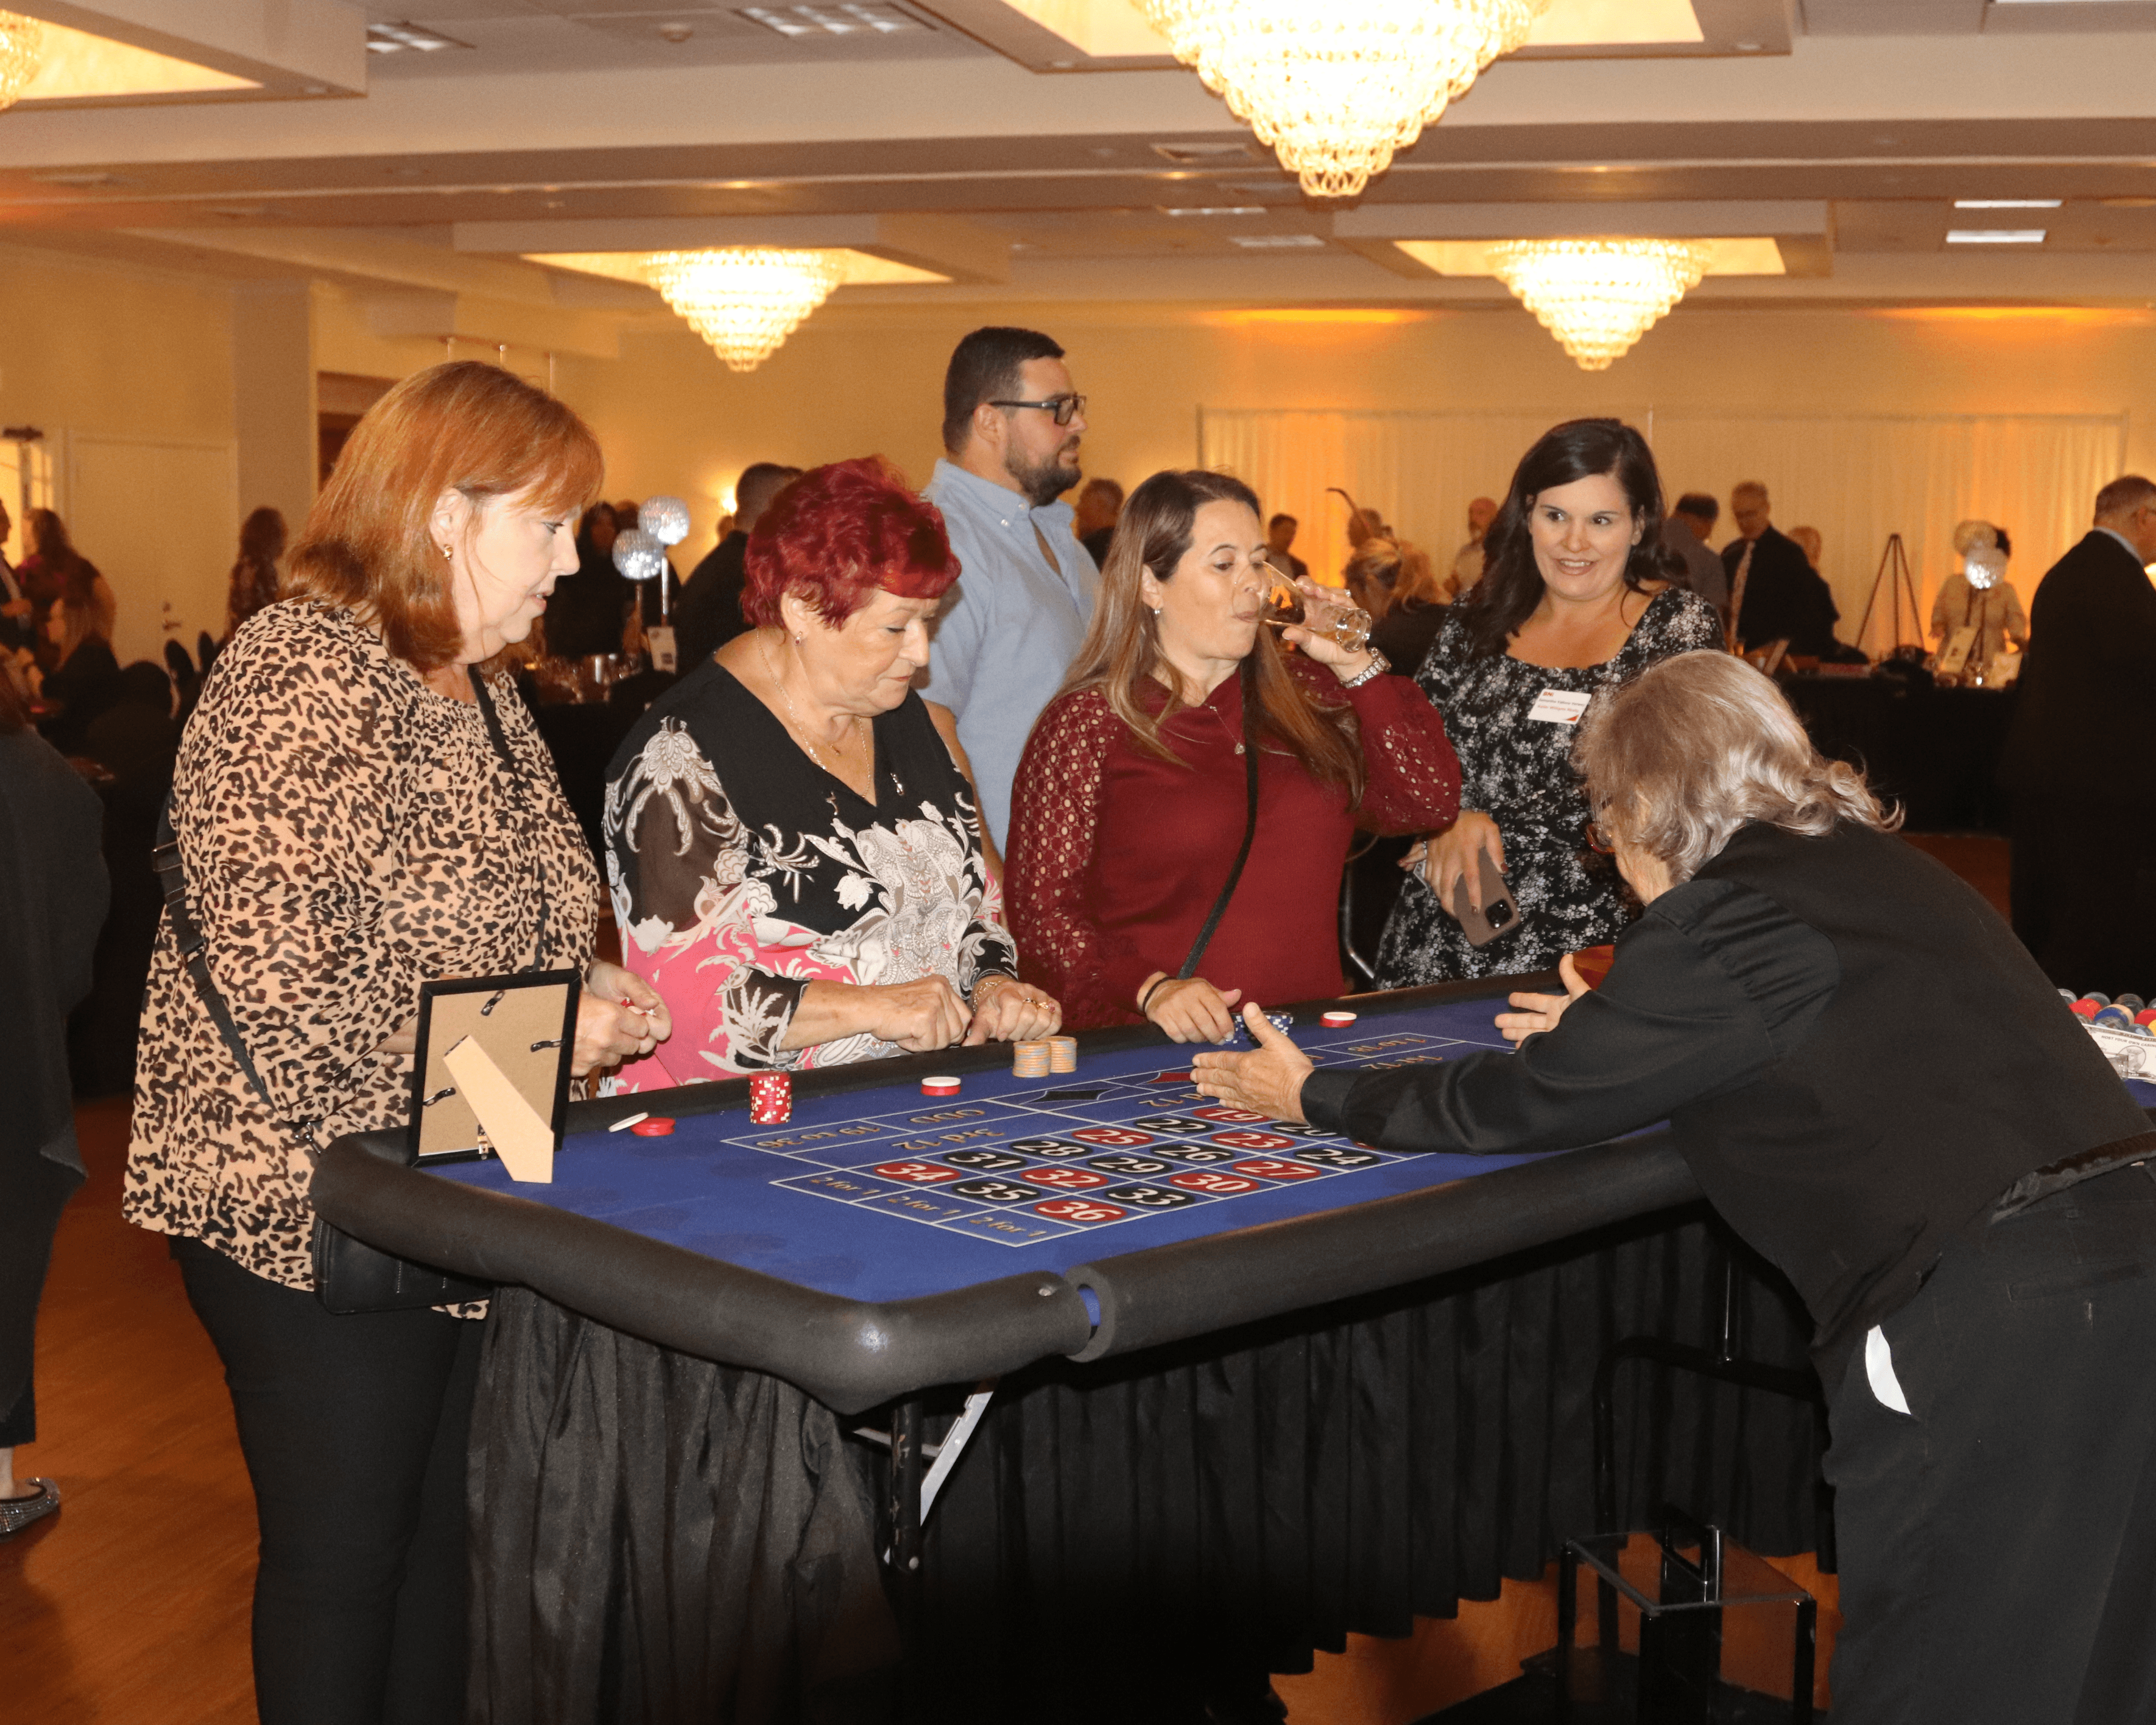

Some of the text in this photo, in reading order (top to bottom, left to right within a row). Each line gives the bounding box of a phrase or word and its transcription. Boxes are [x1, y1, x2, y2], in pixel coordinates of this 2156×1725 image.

[910, 1109, 985, 1123] ODD
[1205, 1109, 1264, 1121] 19
[839, 1125, 880, 1135] 19
[1137, 1118, 1206, 1133] 22
[756, 1137, 804, 1148] 36
[892, 1129, 1005, 1150] 3rd 12
[1076, 1130, 1148, 1144] 25
[1216, 1133, 1287, 1147] 23
[1013, 1141, 1085, 1156] 28
[1154, 1145, 1231, 1161] 26
[948, 1153, 1021, 1168] 31
[1296, 1148, 1374, 1165] 24
[877, 1164, 953, 1181] 34
[1091, 1157, 1165, 1173] 29
[1236, 1161, 1315, 1176] 27
[826, 1181, 862, 1191] for
[1025, 1170, 1100, 1188] 32
[1174, 1174, 1250, 1191] 30
[957, 1183, 1037, 1200] 35
[1108, 1188, 1186, 1205] 33
[904, 1200, 940, 1211] for
[1038, 1202, 1121, 1221] 36
[988, 1221, 1027, 1233] for
